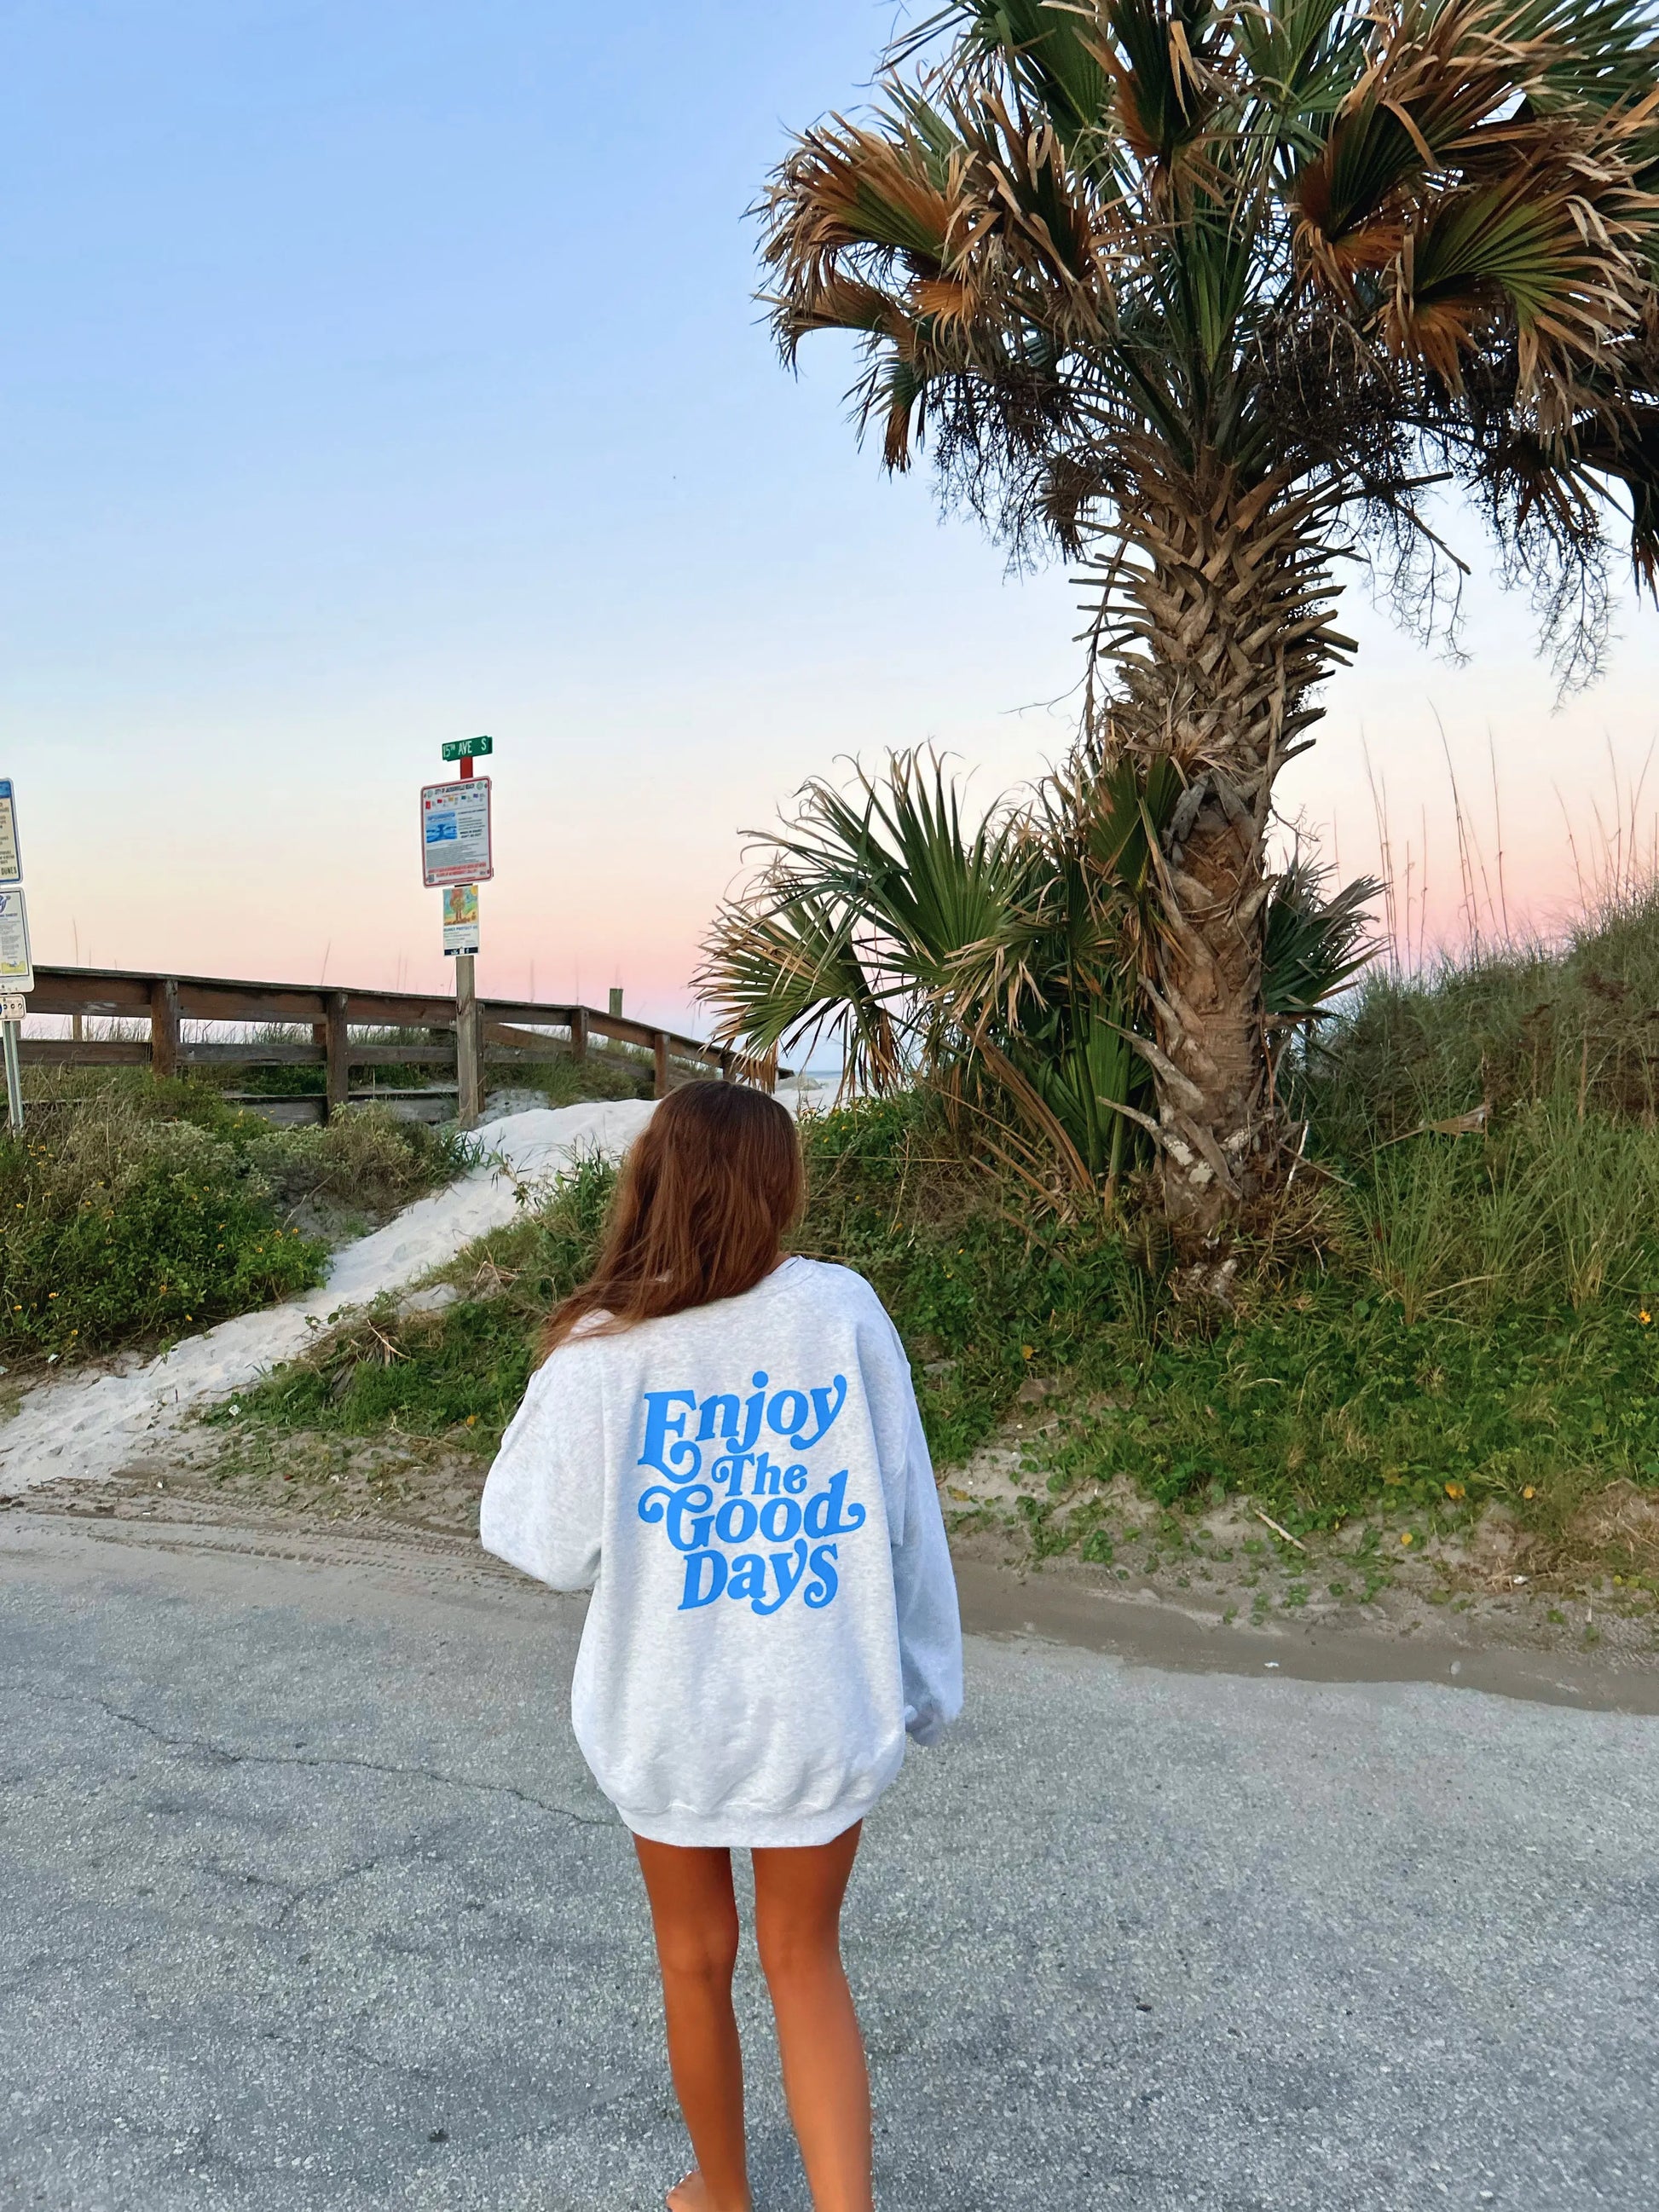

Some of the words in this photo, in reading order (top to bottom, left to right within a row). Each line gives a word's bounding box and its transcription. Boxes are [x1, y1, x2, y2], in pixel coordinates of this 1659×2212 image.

[458, 740, 472, 756] AVE
[481, 737, 487, 751] S
[1, 866, 17, 875] DUNES
[637, 1371, 847, 1484] Enjoy
[711, 1452, 808, 1497] The
[638, 1470, 866, 1551] Good
[678, 1538, 839, 1615] Days
